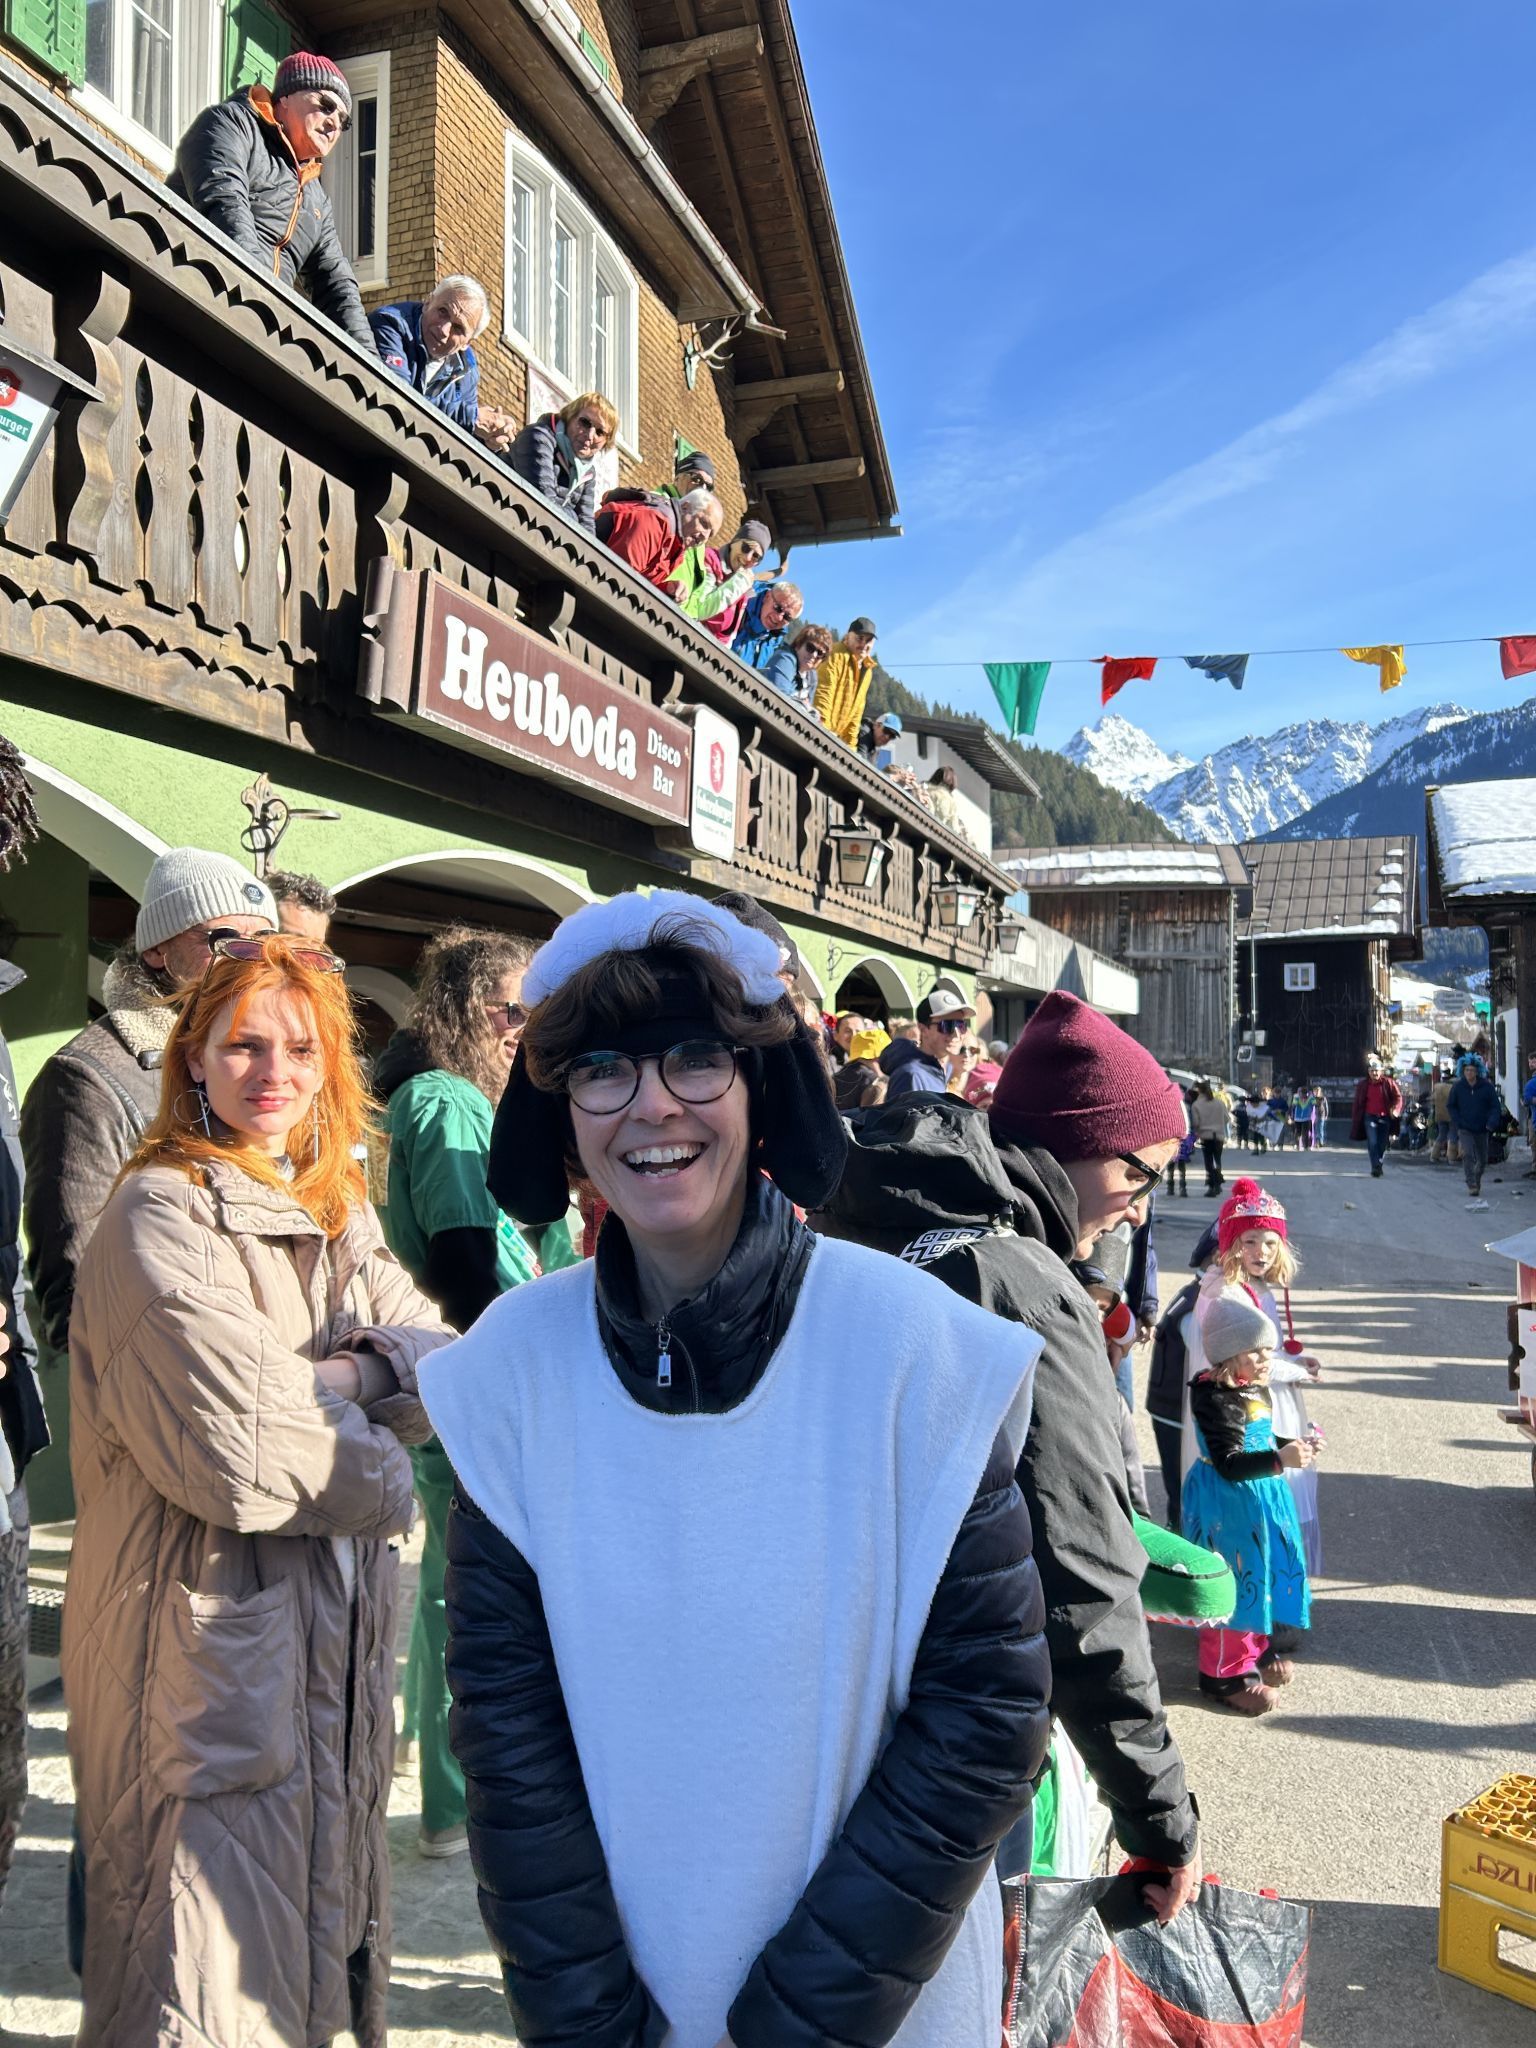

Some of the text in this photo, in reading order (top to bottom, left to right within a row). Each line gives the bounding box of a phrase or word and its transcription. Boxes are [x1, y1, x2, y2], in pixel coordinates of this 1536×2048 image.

[0, 415, 29, 436] urger
[440, 615, 637, 780] Heuboda
[647, 728, 682, 768] Disco
[652, 765, 675, 797] Bar
[1467, 1852, 1536, 1894] nzer
